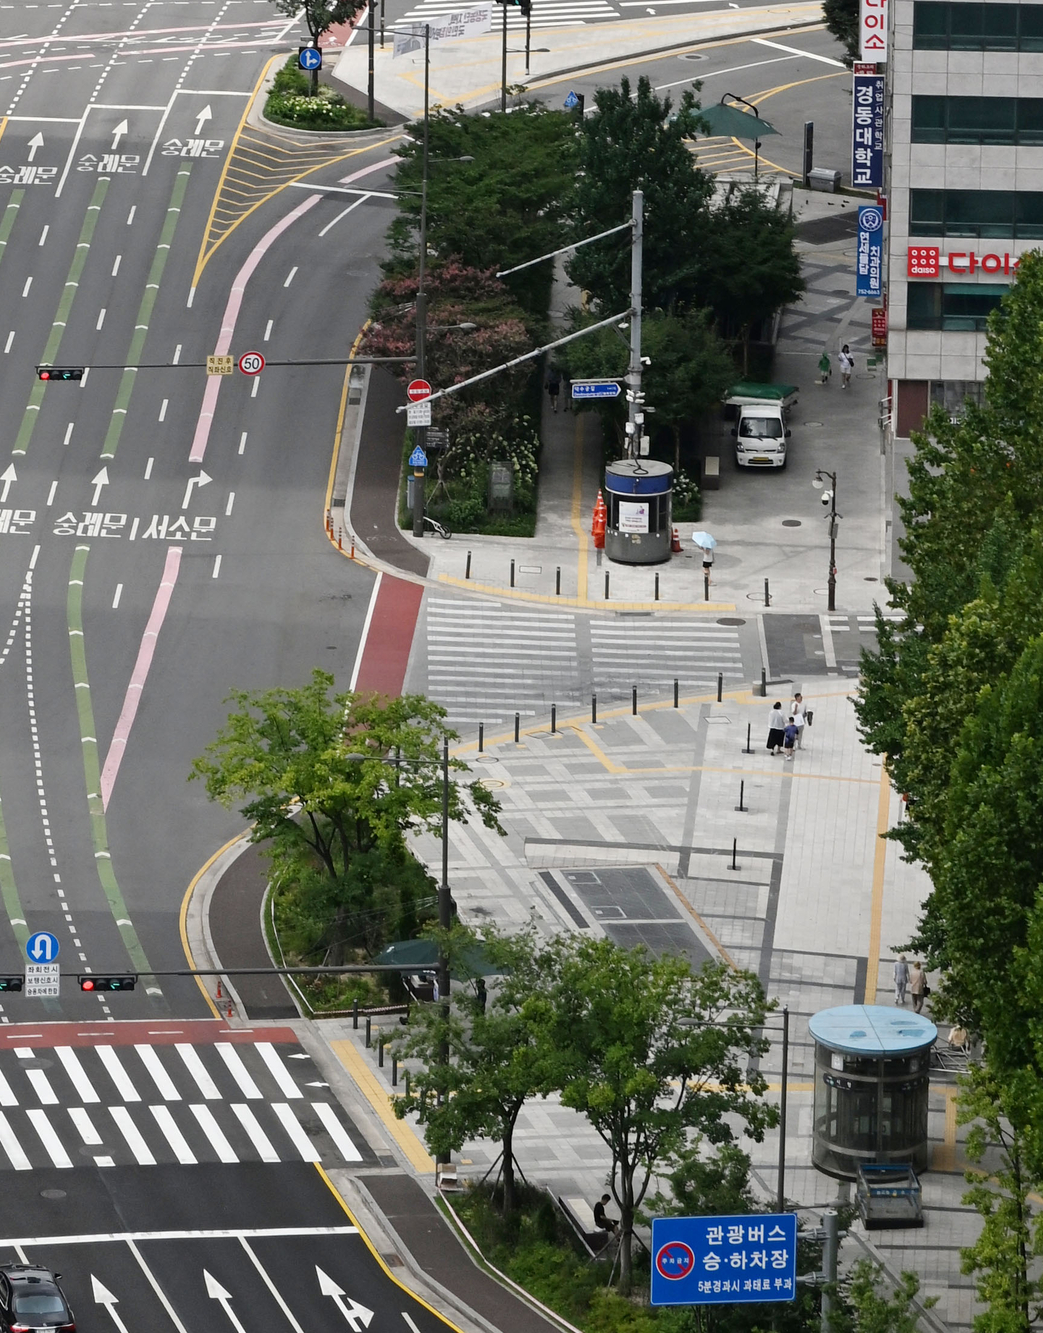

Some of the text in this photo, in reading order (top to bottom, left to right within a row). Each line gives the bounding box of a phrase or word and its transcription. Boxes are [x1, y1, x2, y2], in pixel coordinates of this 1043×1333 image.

[853, 85, 874, 185] 경동대학교
[162, 137, 225, 159] 숭례문
[77, 152, 143, 175] 숭례문
[869, 245, 881, 290] 치과의원
[911, 266, 936, 275] daiso
[948, 251, 1021, 276] 다이
[243, 357, 260, 370] 50
[53, 511, 128, 539] 숭례문
[142, 514, 217, 541] 서소문
[27, 966, 58, 974] 좌회전시
[27, 976, 58, 985] 보행신호시
[705, 1224, 787, 1246] 관광버스
[661, 1257, 690, 1265] 주차금지
[702, 1249, 789, 1272] 승·하차장
[698, 1276, 793, 1294] 5분경과시 과태료 부과
